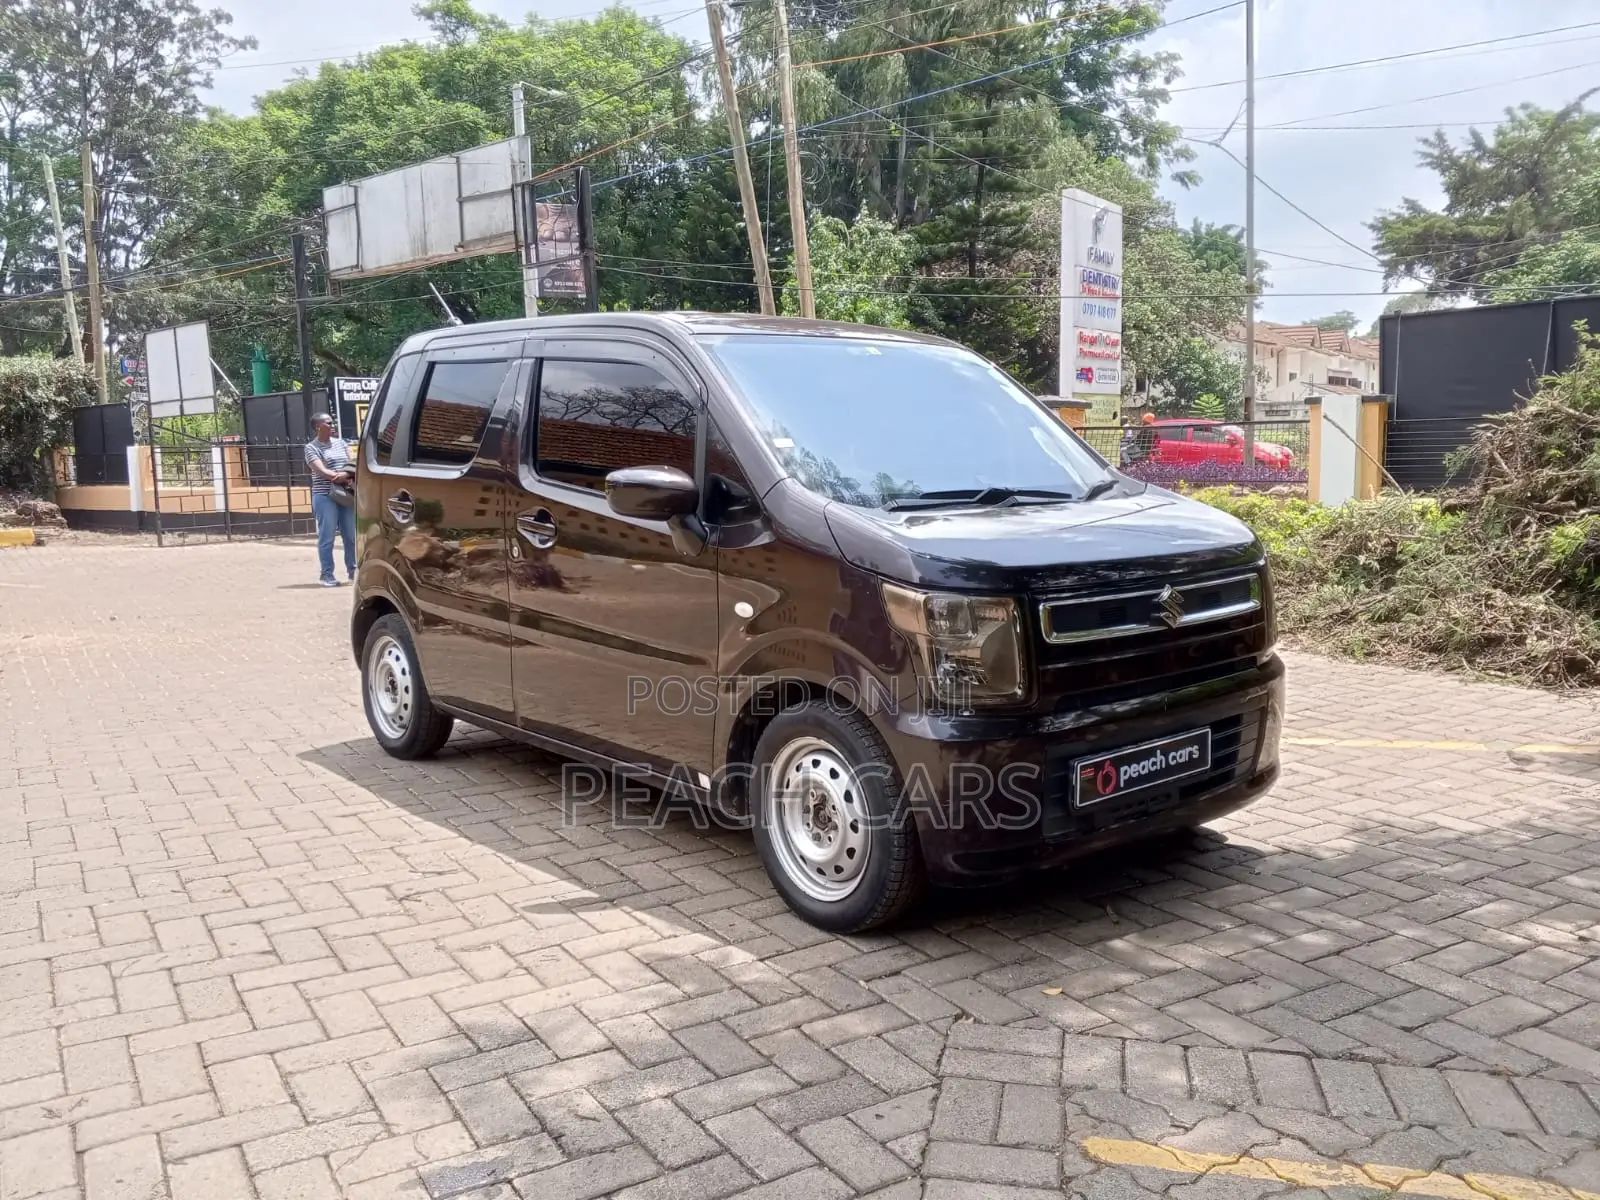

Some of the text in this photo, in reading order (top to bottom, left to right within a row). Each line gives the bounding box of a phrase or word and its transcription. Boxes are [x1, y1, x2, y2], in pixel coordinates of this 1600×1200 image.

[339, 380, 361, 392] Kenya
[1120, 744, 1200, 788] peach cars
